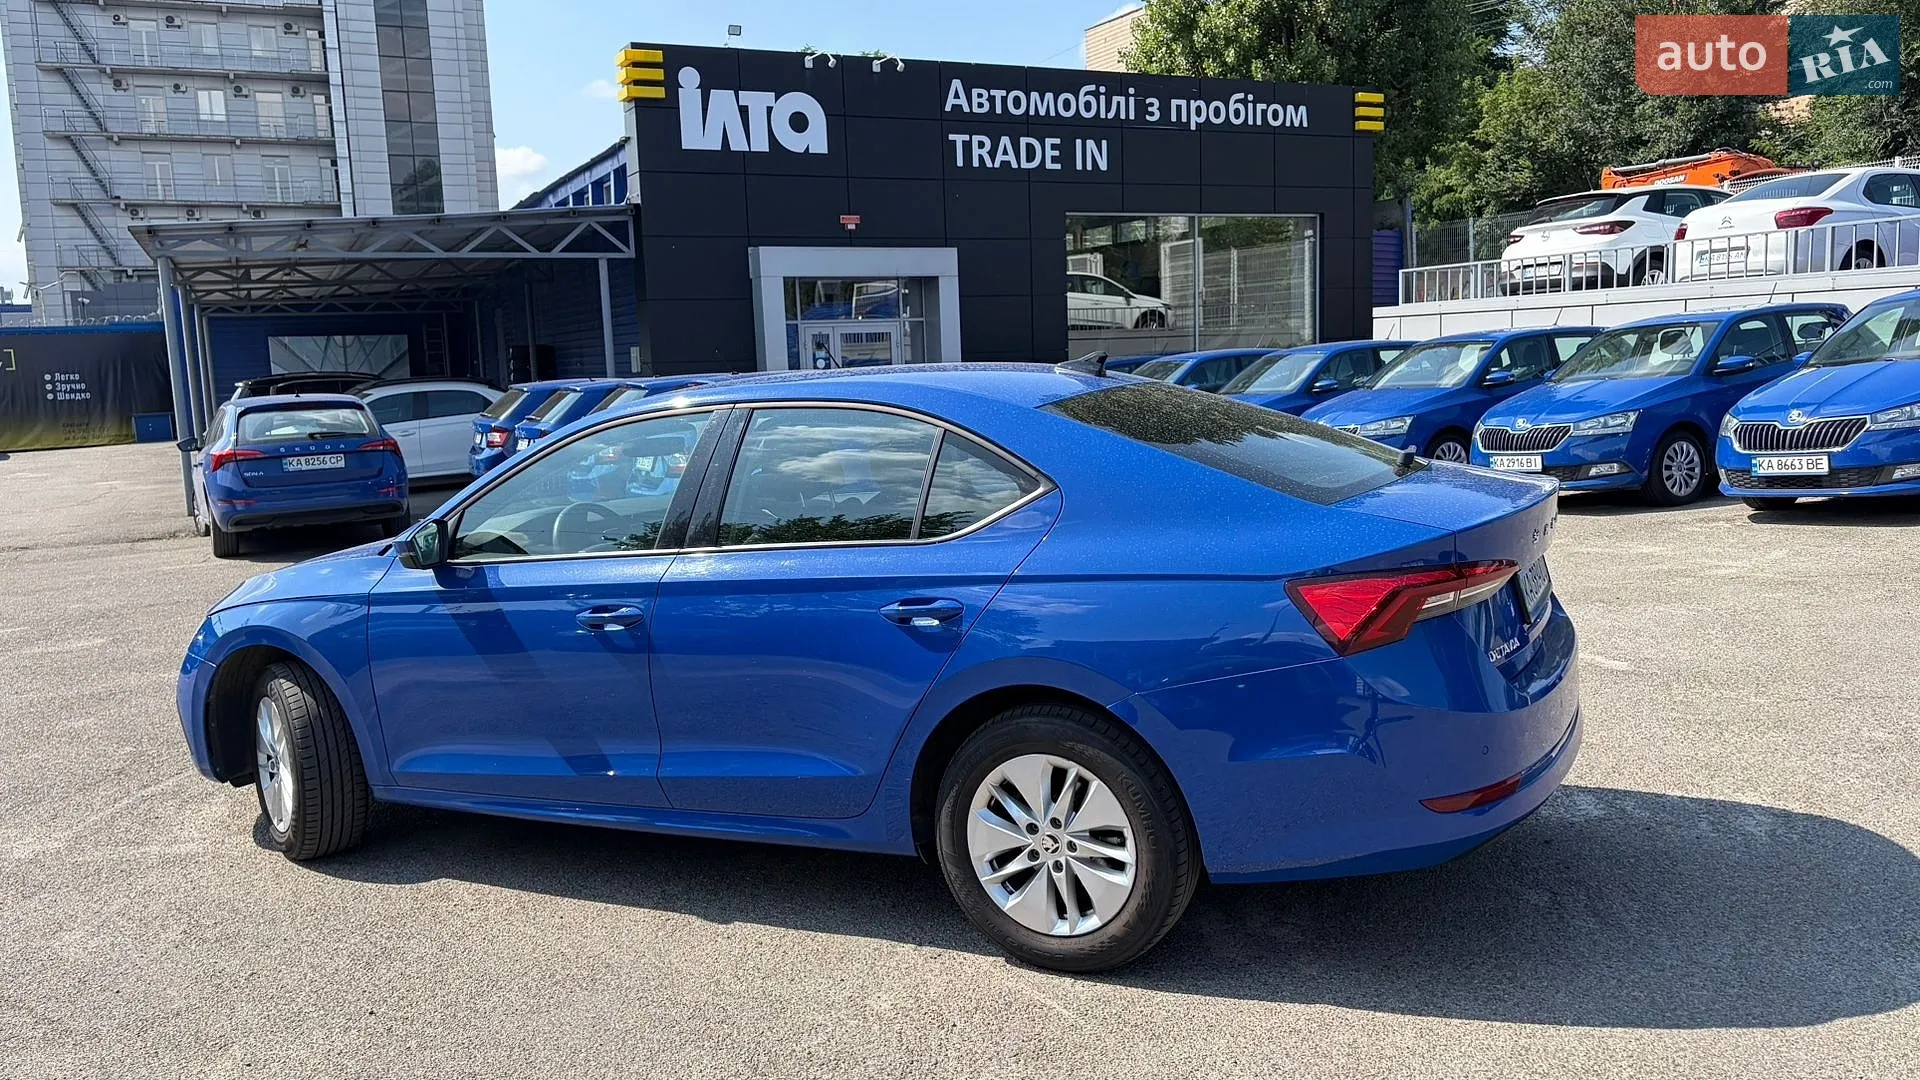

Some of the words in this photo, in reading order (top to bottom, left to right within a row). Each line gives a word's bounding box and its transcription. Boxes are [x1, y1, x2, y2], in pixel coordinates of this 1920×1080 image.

[944, 78, 1136, 121] Автомобілі
[1145, 97, 1161, 122] з
[1170, 92, 1309, 131] пробігом
[948, 133, 1062, 170] TRADE
[1075, 138, 1108, 171] IN
[1653, 175, 1686, 186] DOOSAN
[54, 372, 80, 381] Легко
[55, 382, 86, 392] Зручно
[57, 392, 91, 400] Швидко
[288, 458, 303, 468] KA
[304, 456, 328, 467] 8256
[329, 455, 343, 465] CP
[1494, 458, 1505, 468] KA
[1506, 458, 1525, 468] 2916
[1526, 457, 1537, 468] BI
[1758, 459, 1774, 471] KA
[1776, 458, 1804, 471] 8663
[1806, 457, 1825, 470] BE
